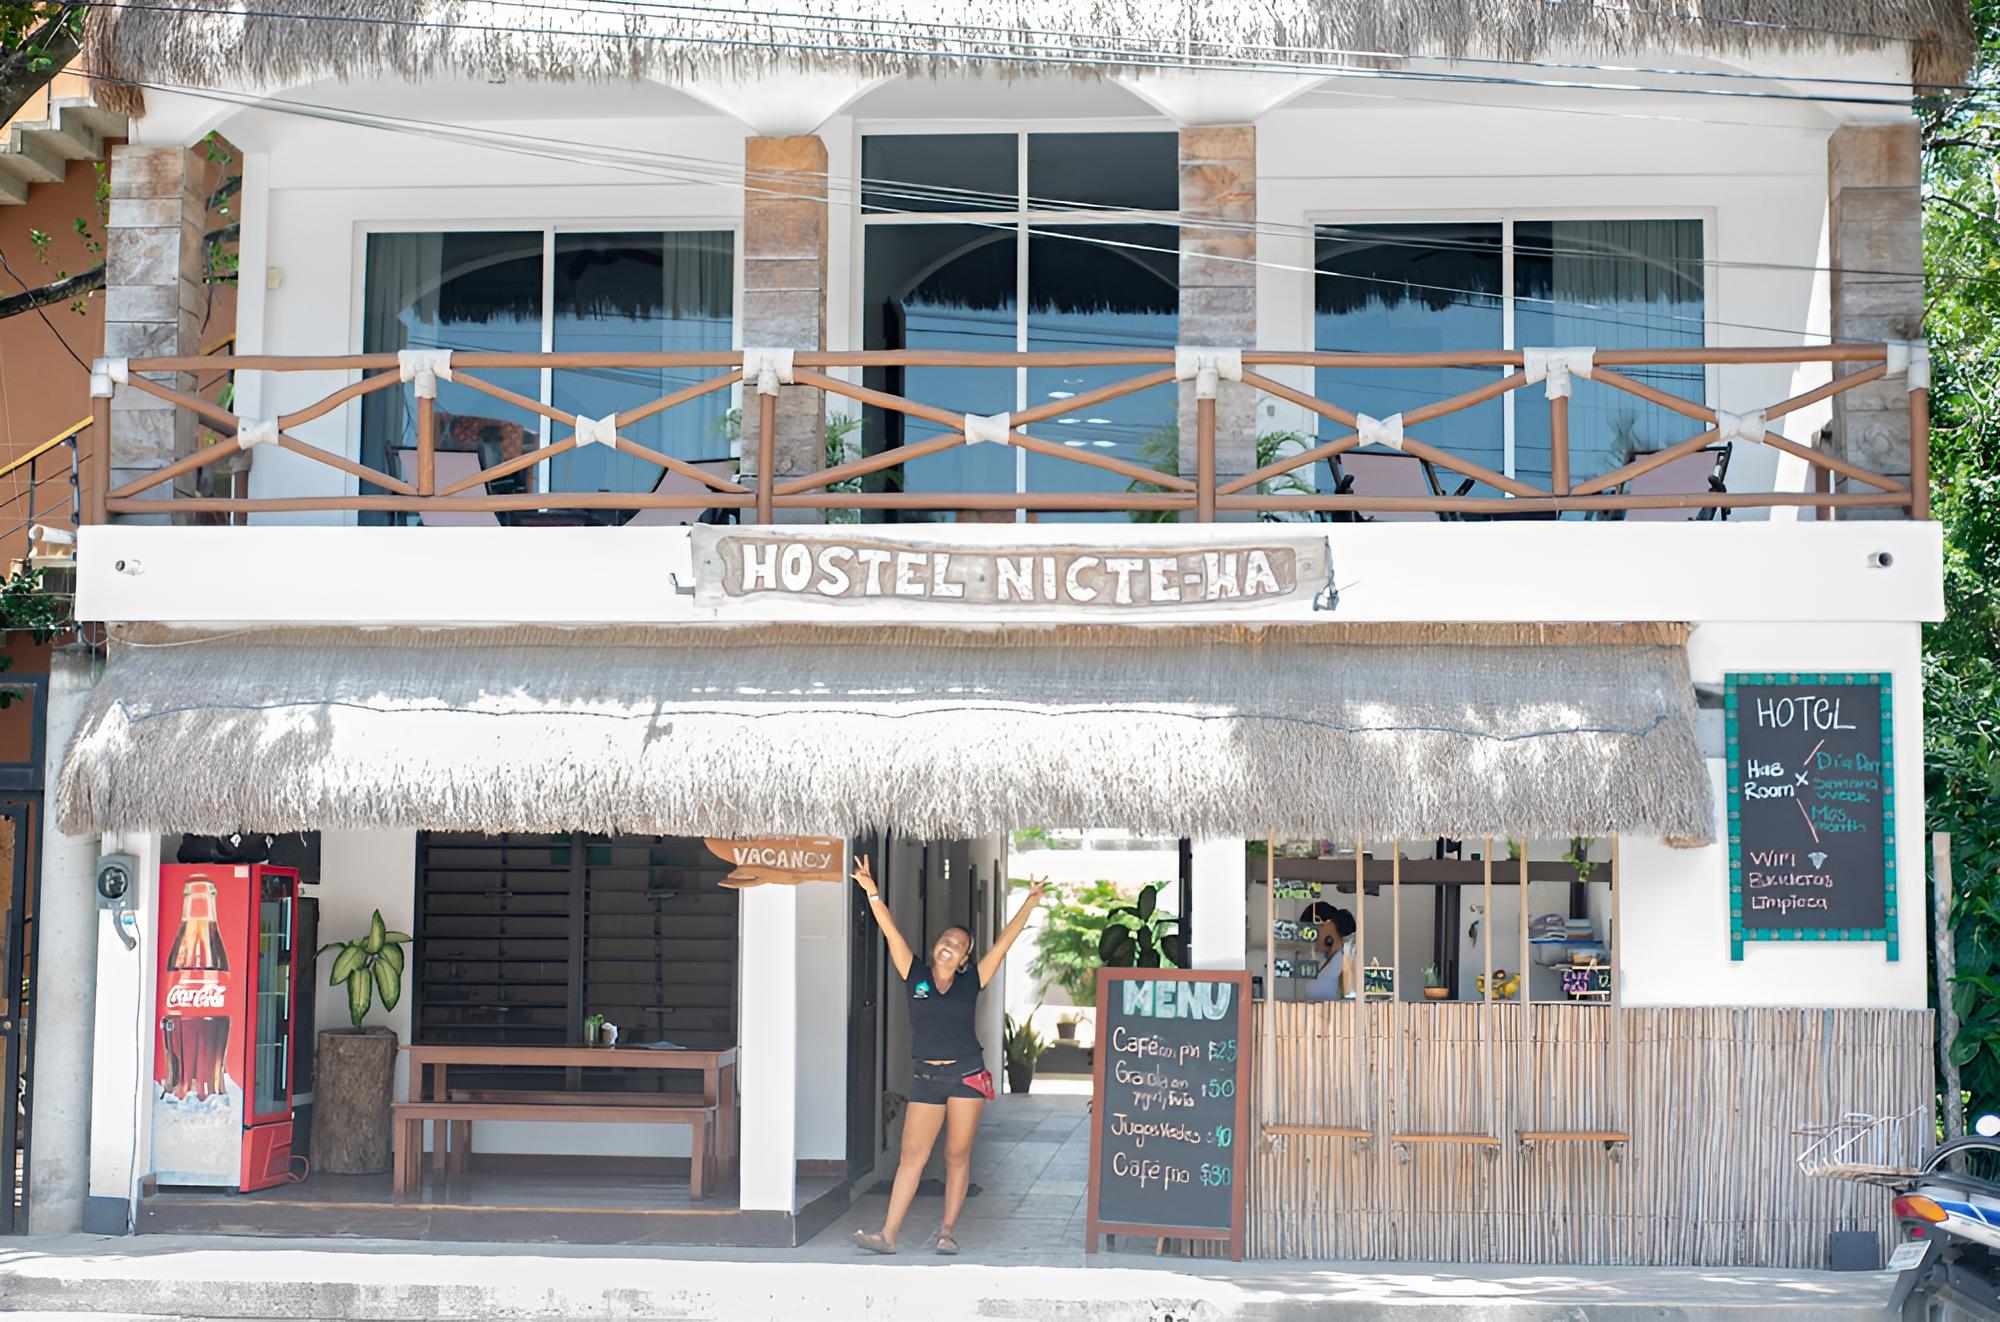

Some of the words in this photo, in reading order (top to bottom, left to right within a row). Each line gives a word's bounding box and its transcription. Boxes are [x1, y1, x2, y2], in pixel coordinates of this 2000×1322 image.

[741, 542, 966, 599] HOSTEL
[996, 549, 1280, 603] NICTE-HA
[1744, 781, 1795, 801] Room
[733, 847, 832, 869] VACANCY
[1123, 979, 1232, 1021] MENU
[1113, 1026, 1158, 1058] Café
[1115, 1060, 1168, 1089] Graola
[1113, 1152, 1160, 1189] Café
